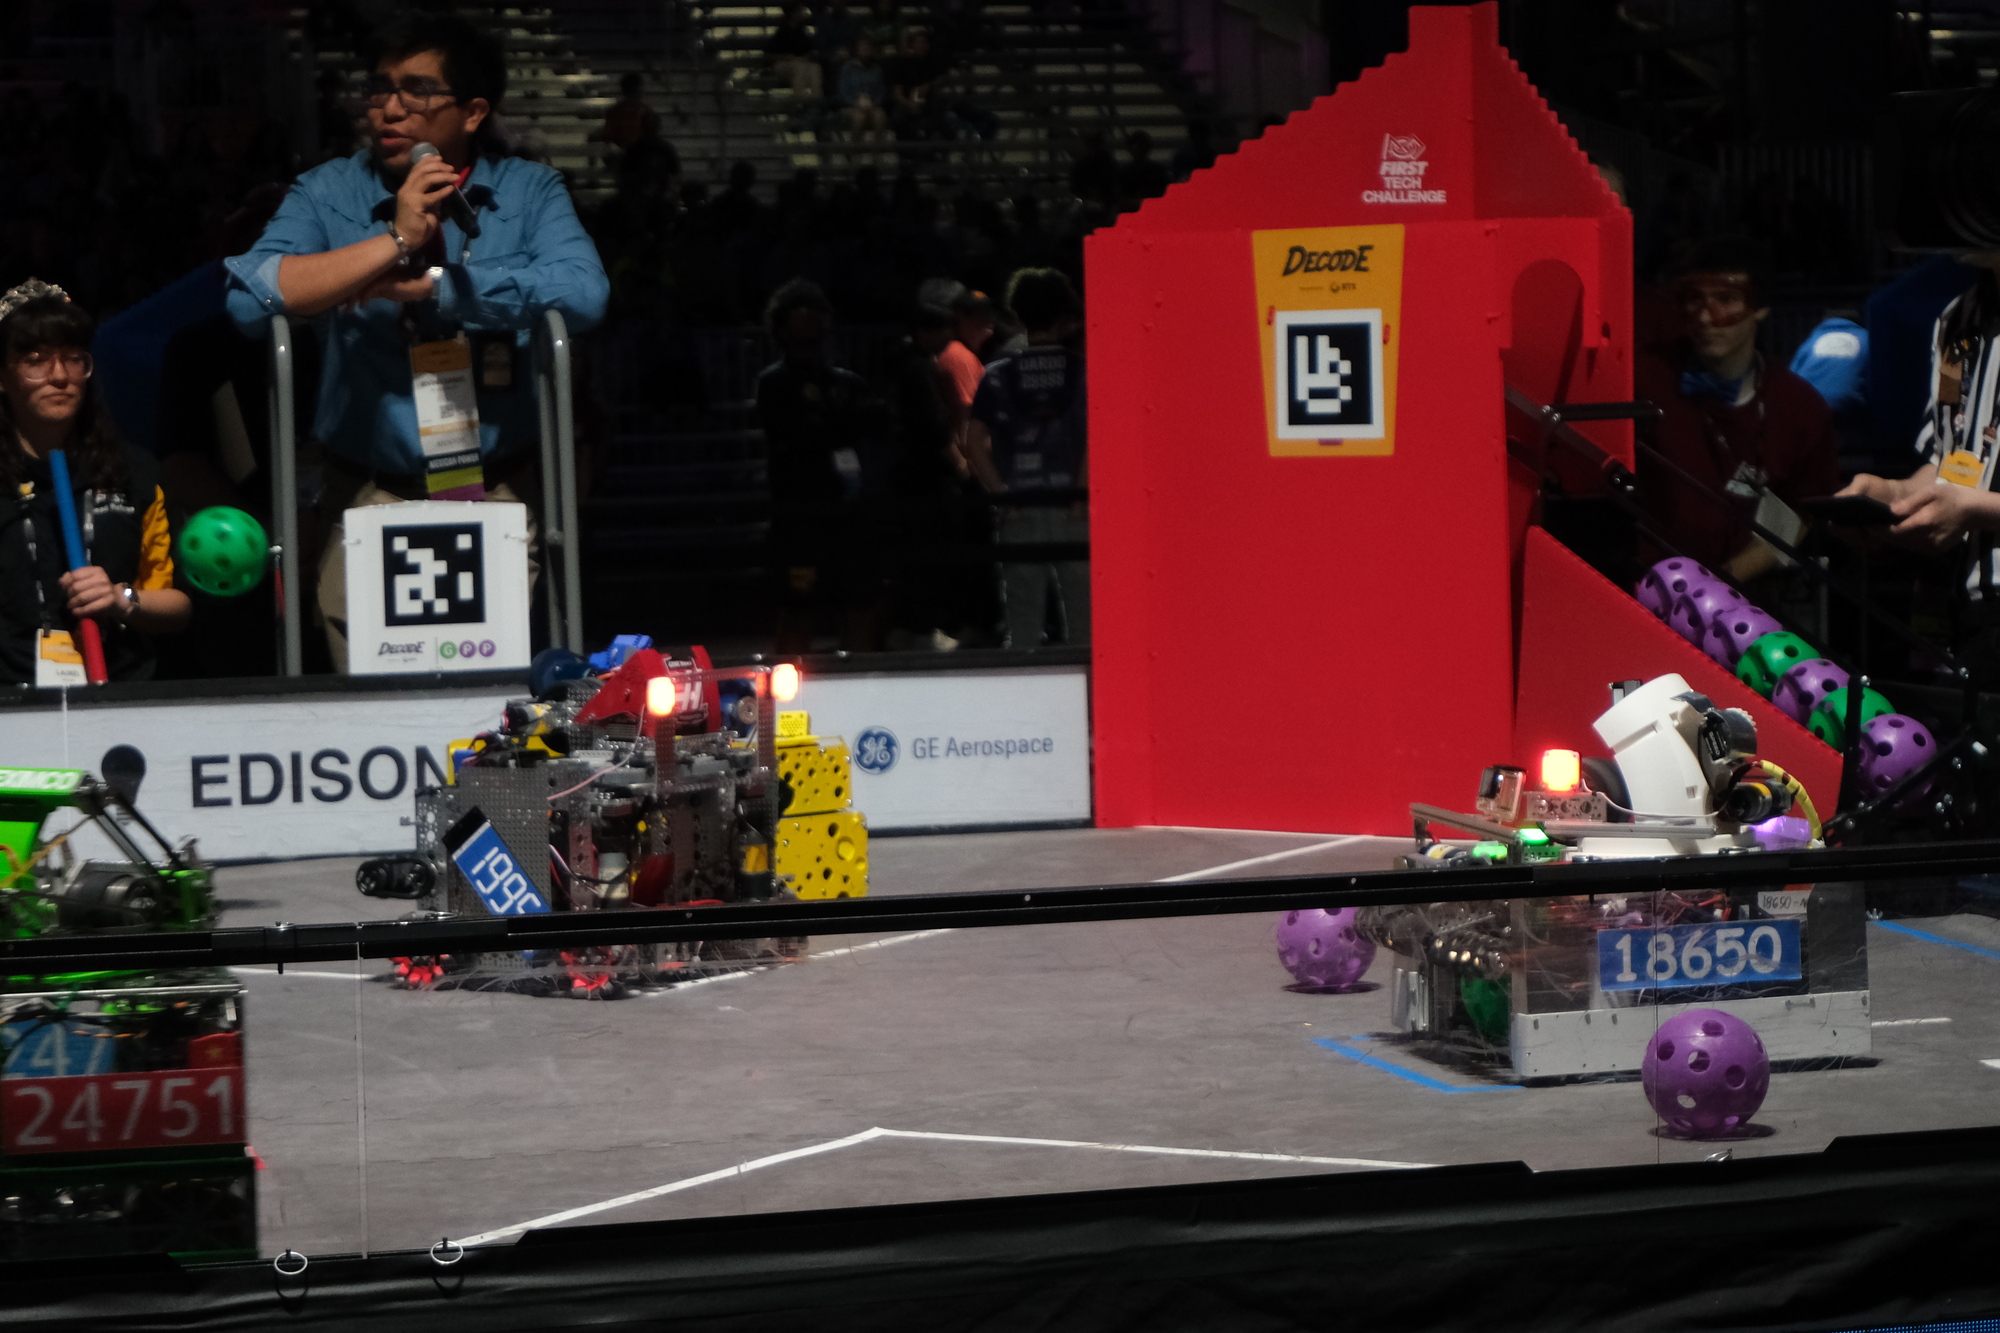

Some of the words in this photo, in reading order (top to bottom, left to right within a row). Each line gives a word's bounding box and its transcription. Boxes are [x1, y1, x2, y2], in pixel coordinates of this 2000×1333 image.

[1380, 161, 1429, 176] FIRST
[1382, 176, 1422, 189] TECH
[1361, 190, 1447, 203] CHALLENGE
[1282, 244, 1374, 277] DECODE
[378, 641, 425, 656] DECODE
[913, 736, 941, 760] GE
[946, 735, 1054, 762] Aerospace
[1616, 925, 1782, 982] 18650
[14, 1075, 235, 1148] 24751
